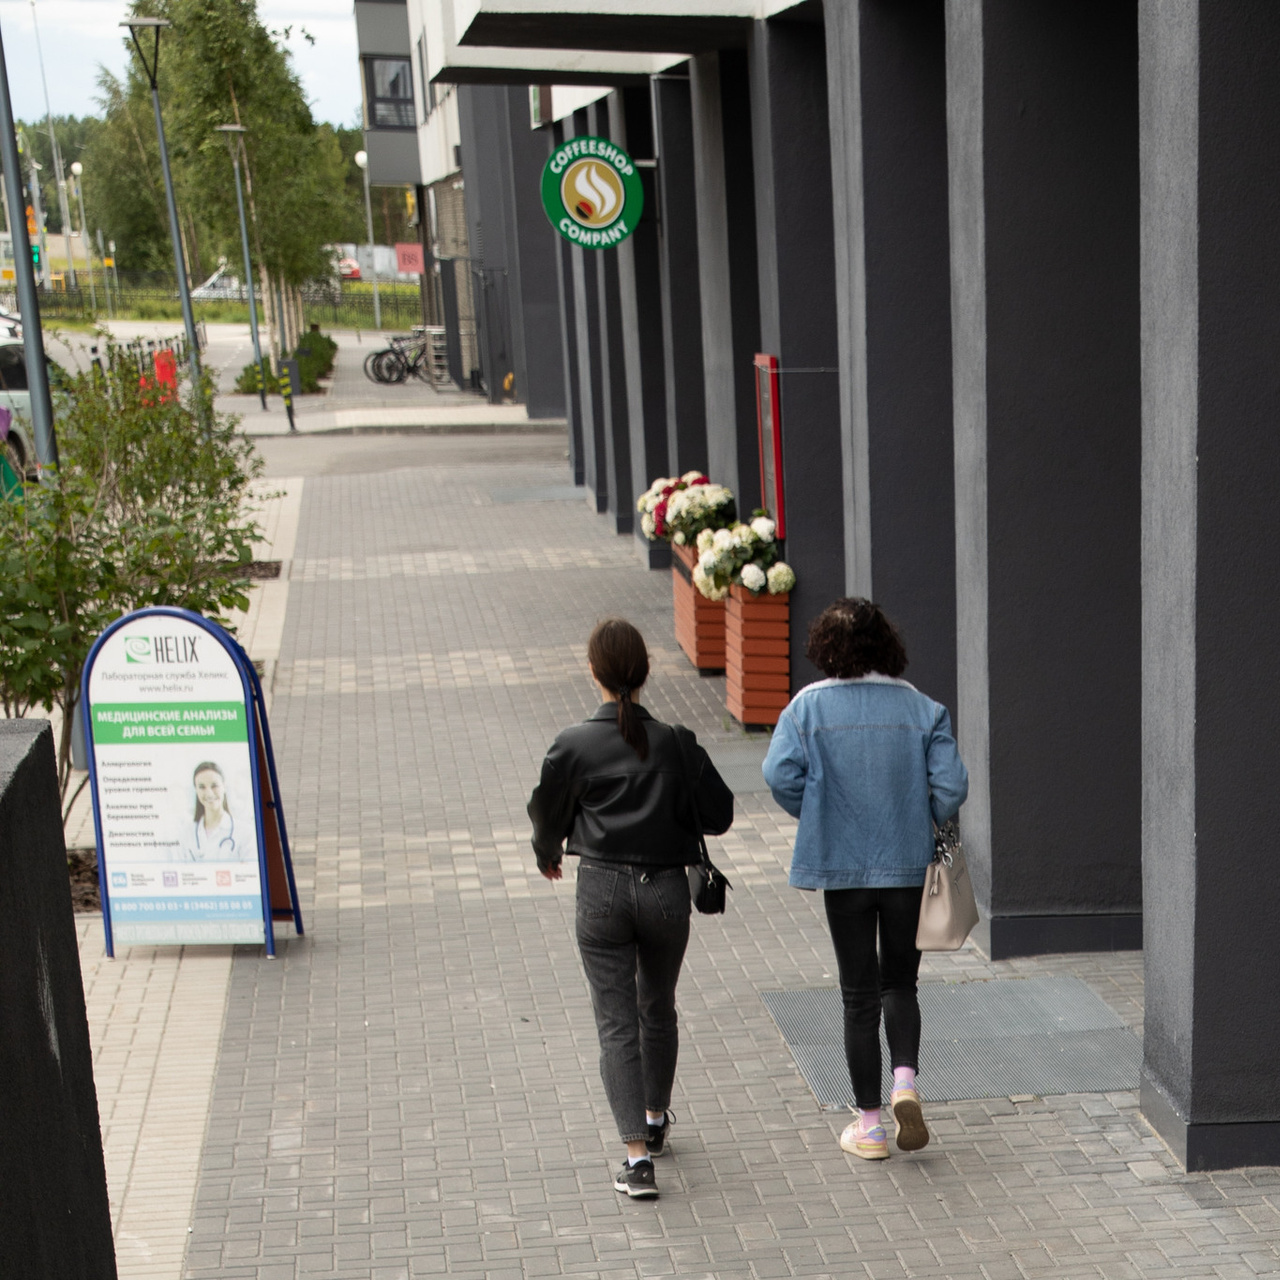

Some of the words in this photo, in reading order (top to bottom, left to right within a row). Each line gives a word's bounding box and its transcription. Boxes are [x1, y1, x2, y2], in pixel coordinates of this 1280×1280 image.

[550, 140, 633, 176] COFFEESHOP
[559, 218, 628, 246] COMPANY
[154, 636, 200, 664] HELIX
[101, 671, 164, 682] Лабораторная
[165, 671, 197, 682] служба
[198, 671, 229, 680] Хеликс
[139, 683, 194, 693] www.helix.ru
[97, 710, 182, 724] МЕДИЦИНСКИЕ
[183, 709, 238, 721] АНАЛИЗЫ
[122, 725, 145, 739] ДЛЯ
[147, 723, 175, 737] ВСЕЙ
[176, 725, 216, 736] СЕМЬИ
